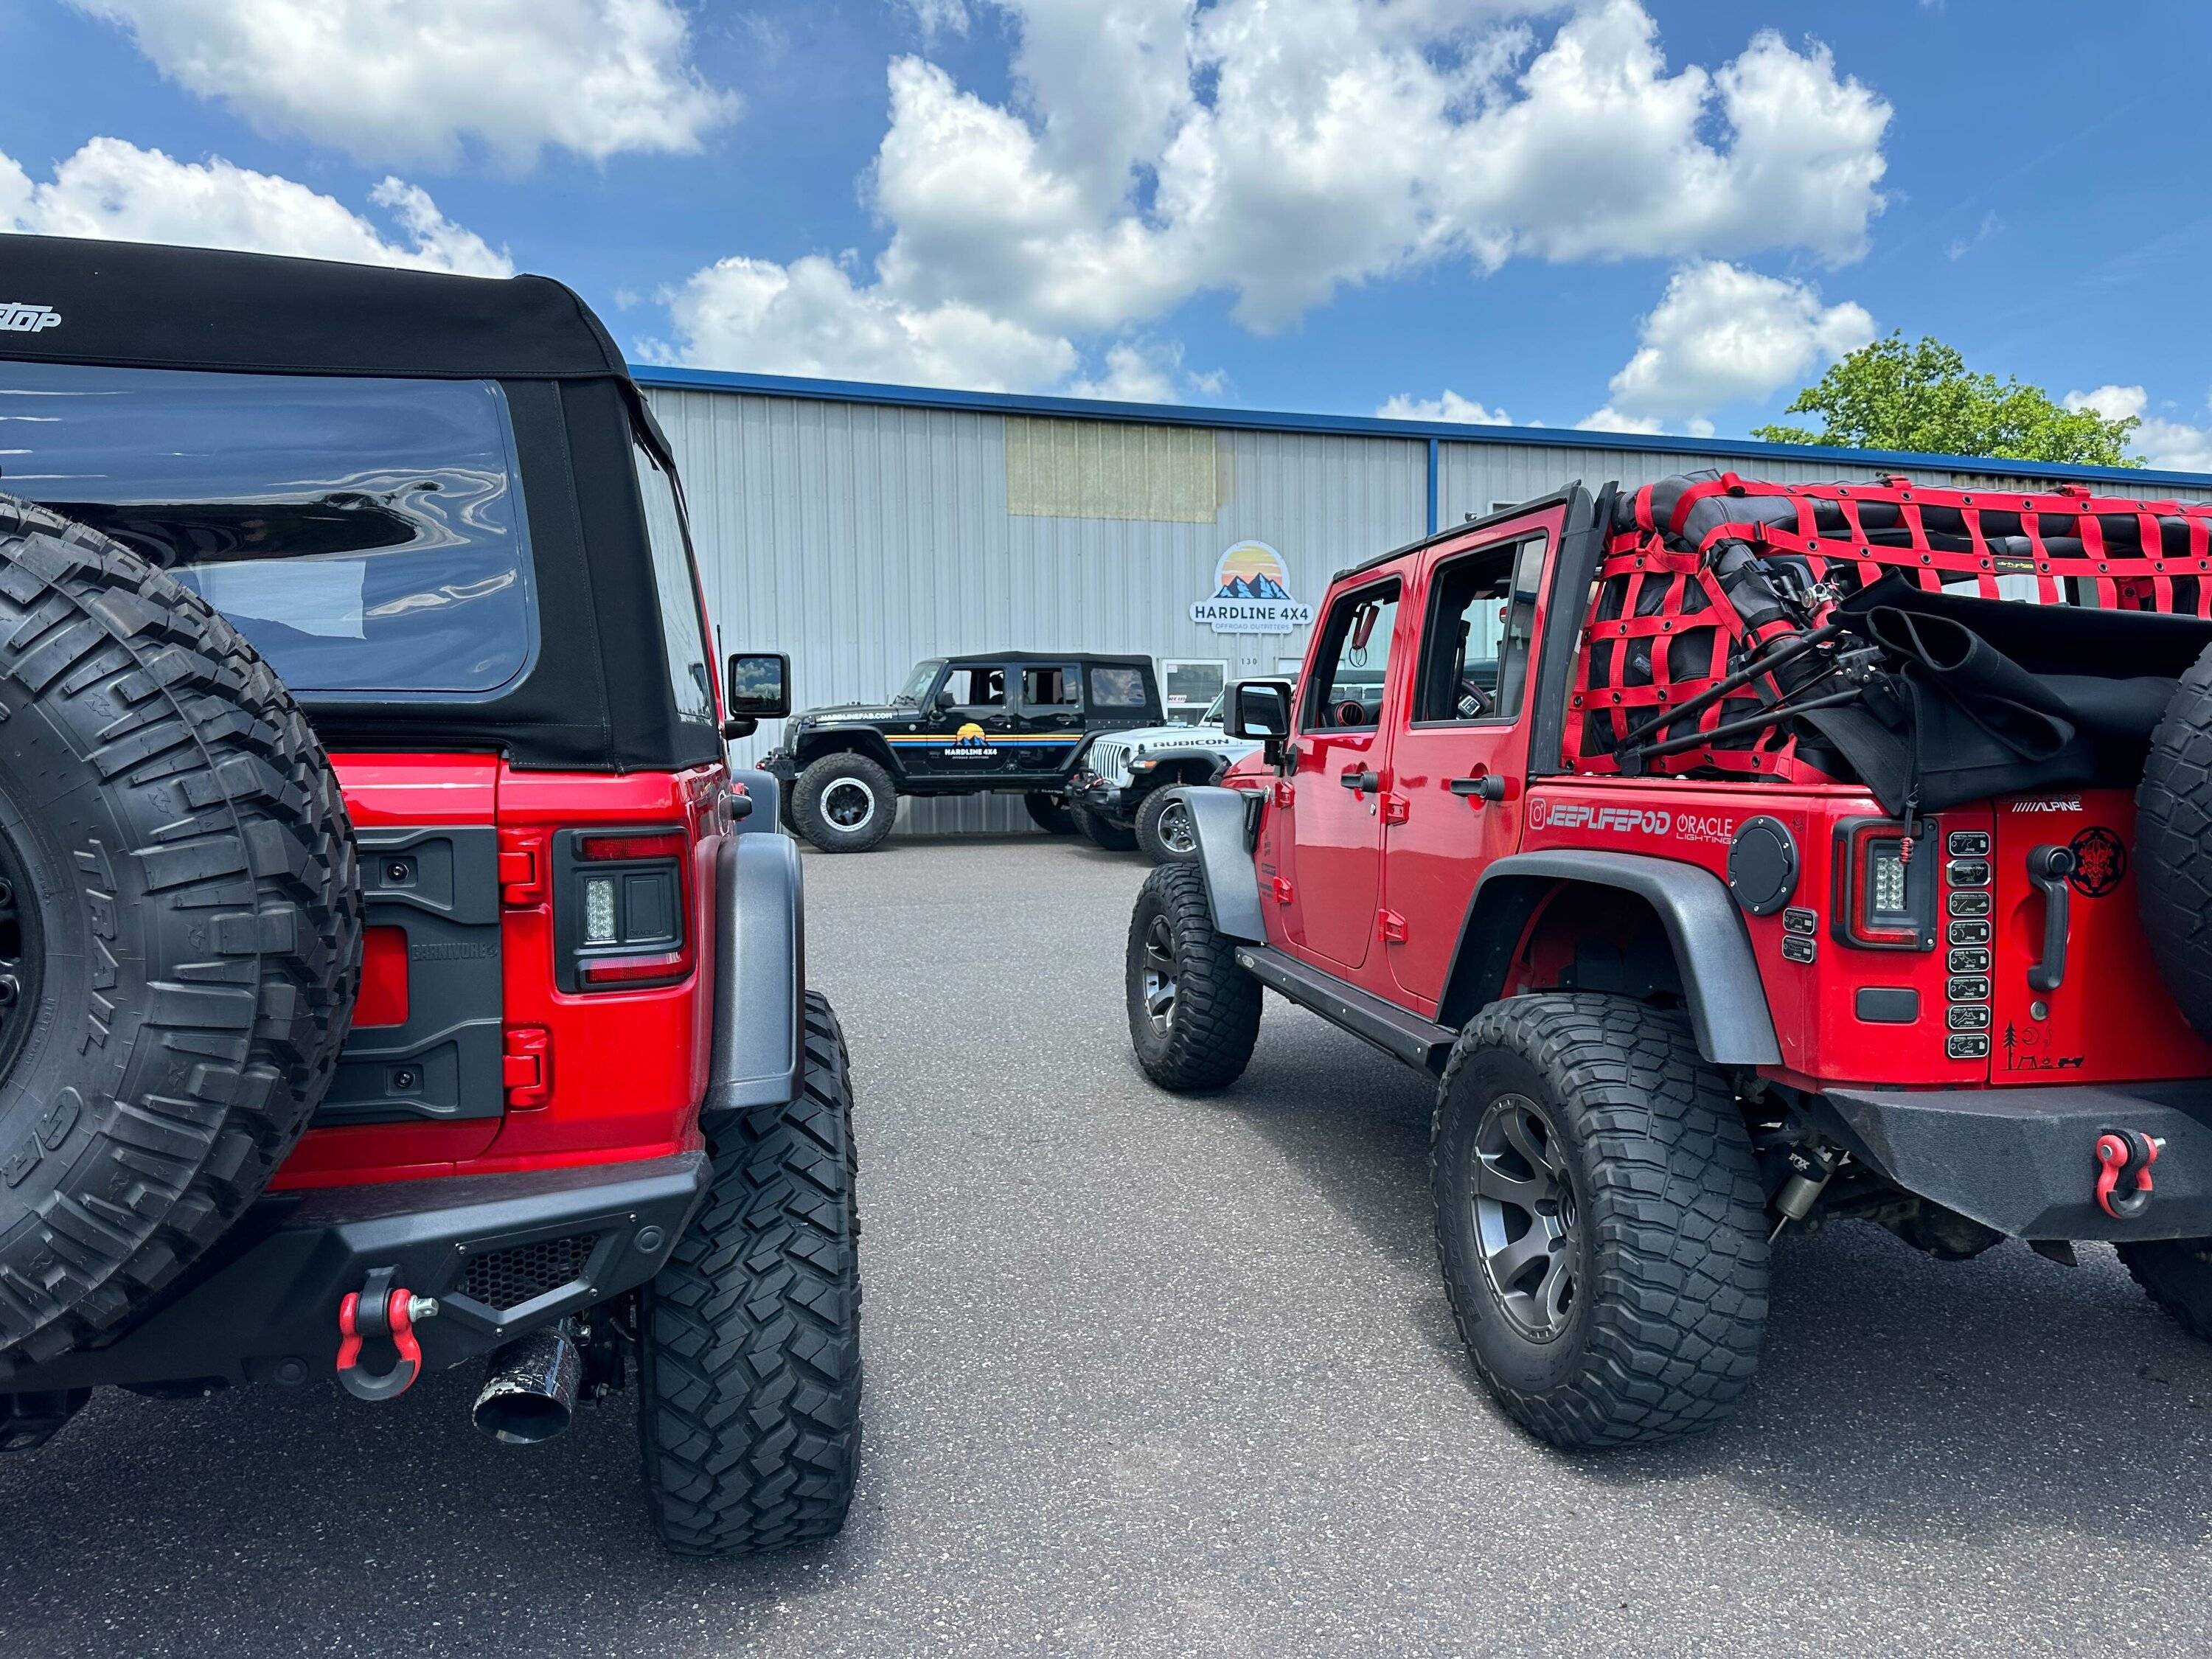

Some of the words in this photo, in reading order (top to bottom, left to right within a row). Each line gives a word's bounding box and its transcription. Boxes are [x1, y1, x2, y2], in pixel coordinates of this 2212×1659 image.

[1195, 606, 1276, 619] HARDLINE
[1280, 608, 1308, 620] 4X4
[1153, 739, 1229, 748] RUBICON
[1547, 804, 1671, 835] JEEPLIFEPOD
[1677, 813, 1733, 838] ORACLE
[1676, 834, 1732, 845] LIGHTING
